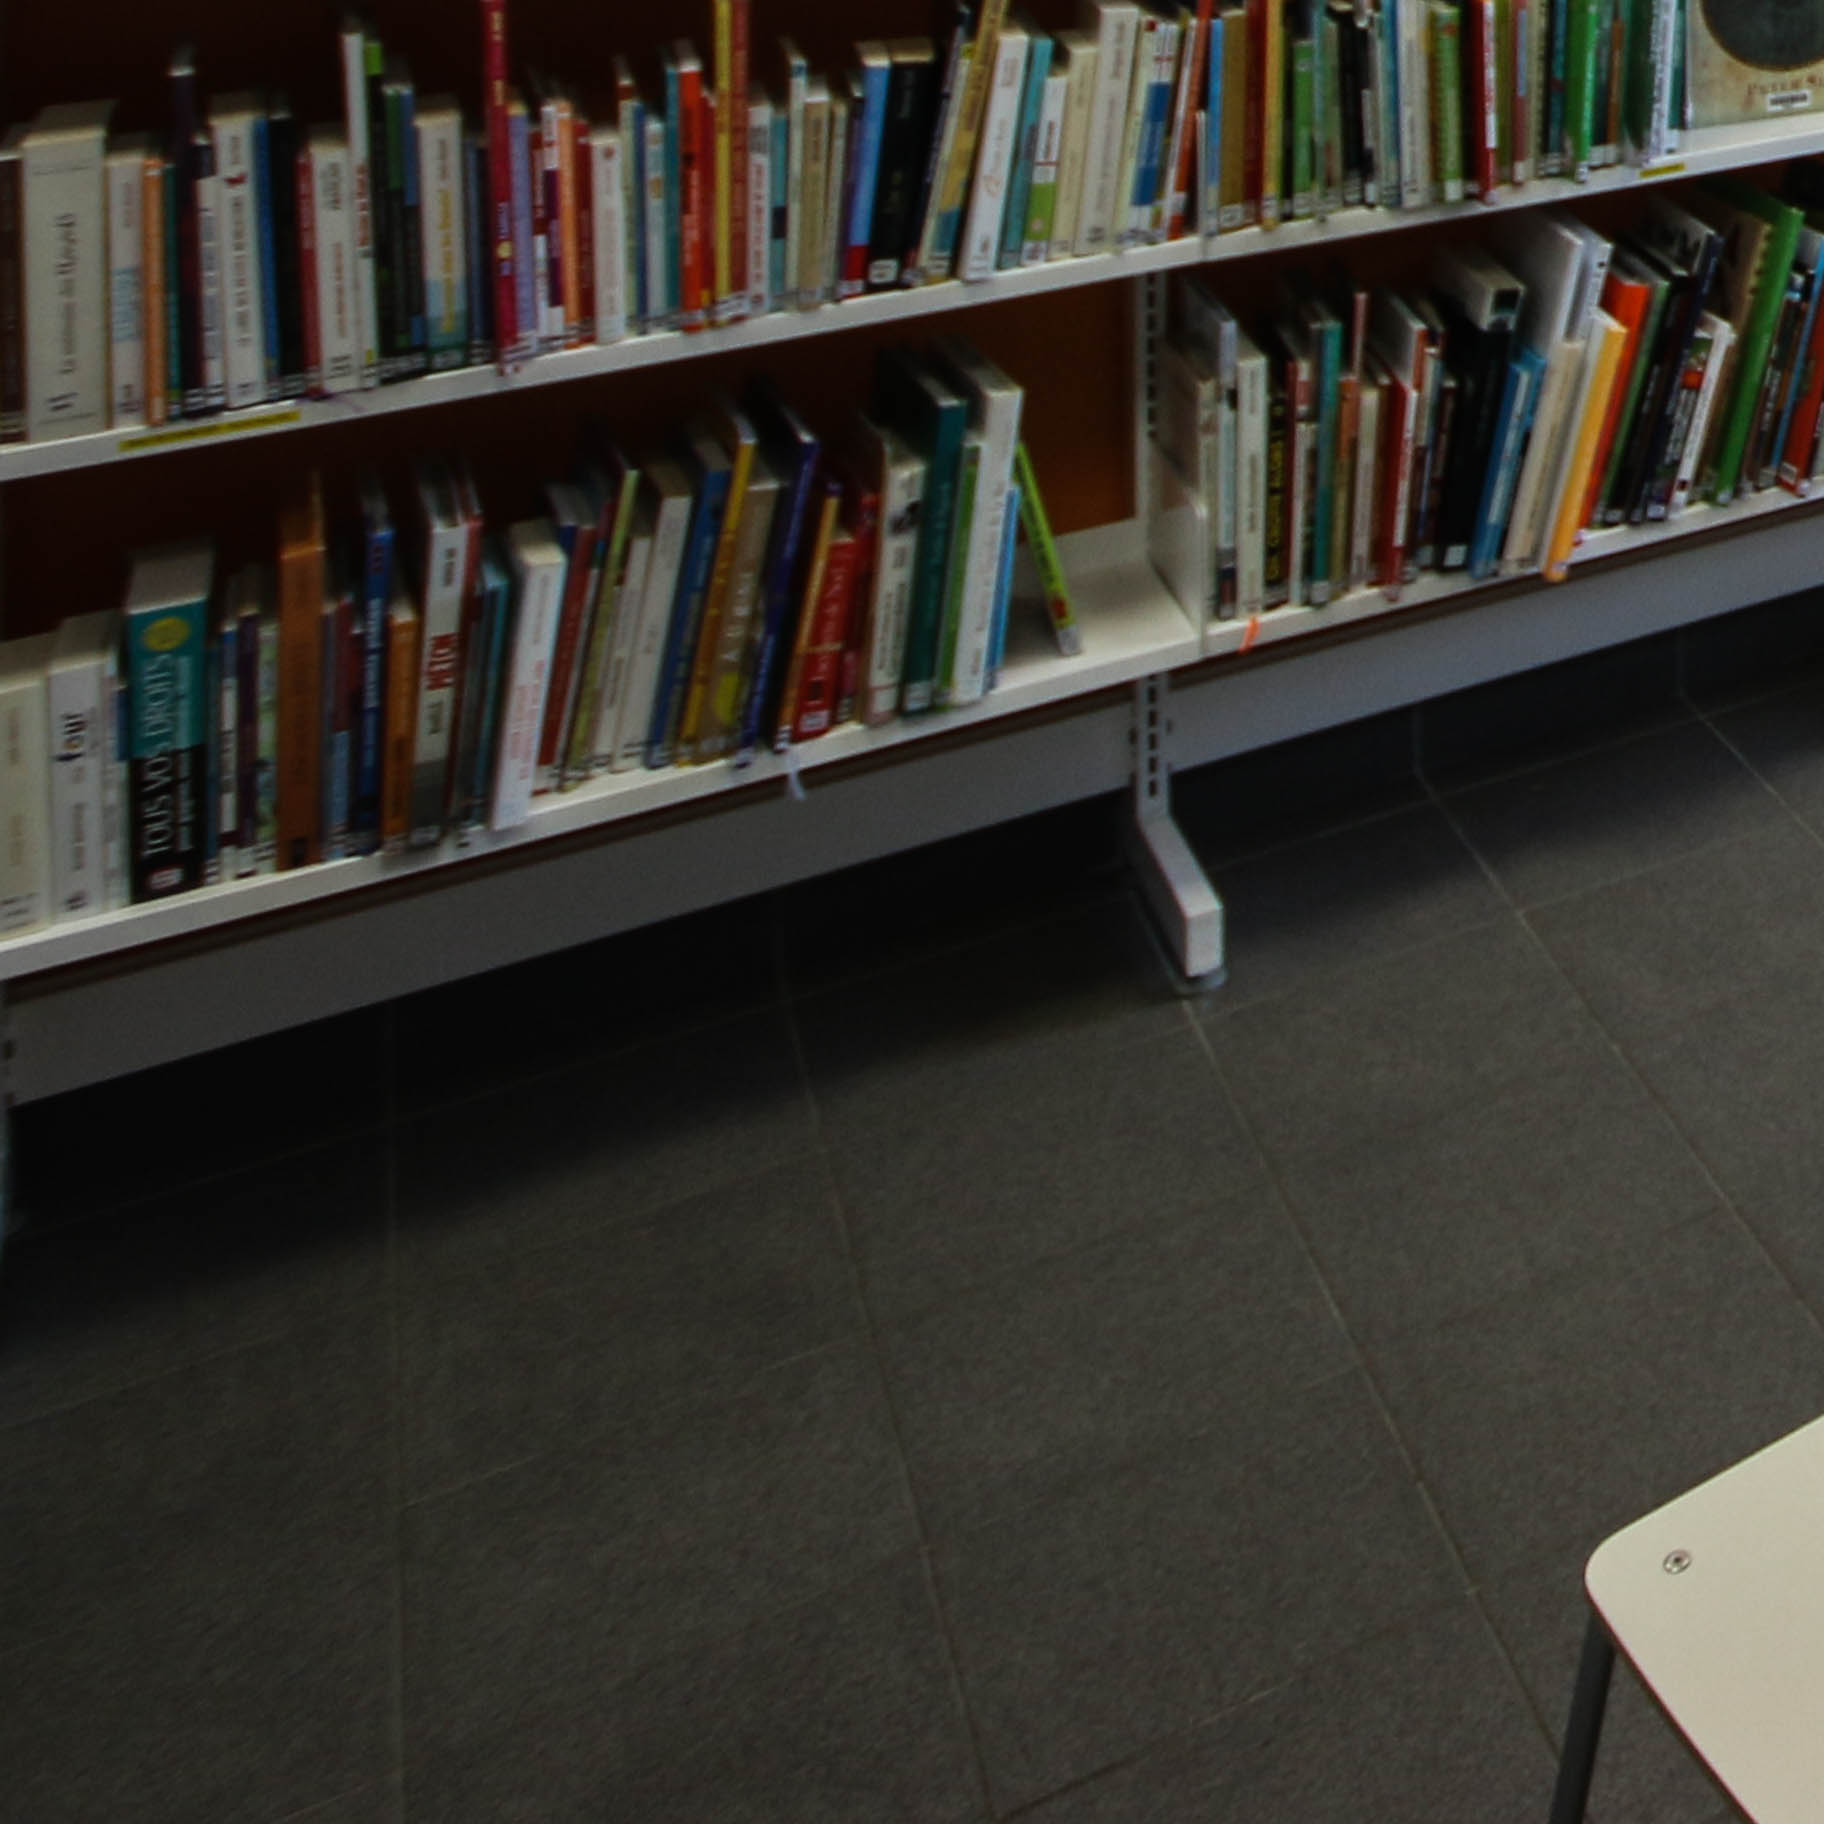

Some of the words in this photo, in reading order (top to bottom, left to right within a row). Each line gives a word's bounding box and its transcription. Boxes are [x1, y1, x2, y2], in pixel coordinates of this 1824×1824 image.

[141, 654, 173, 739] DROITS
[141, 744, 174, 792] VOS
[141, 795, 175, 857] TOUS
